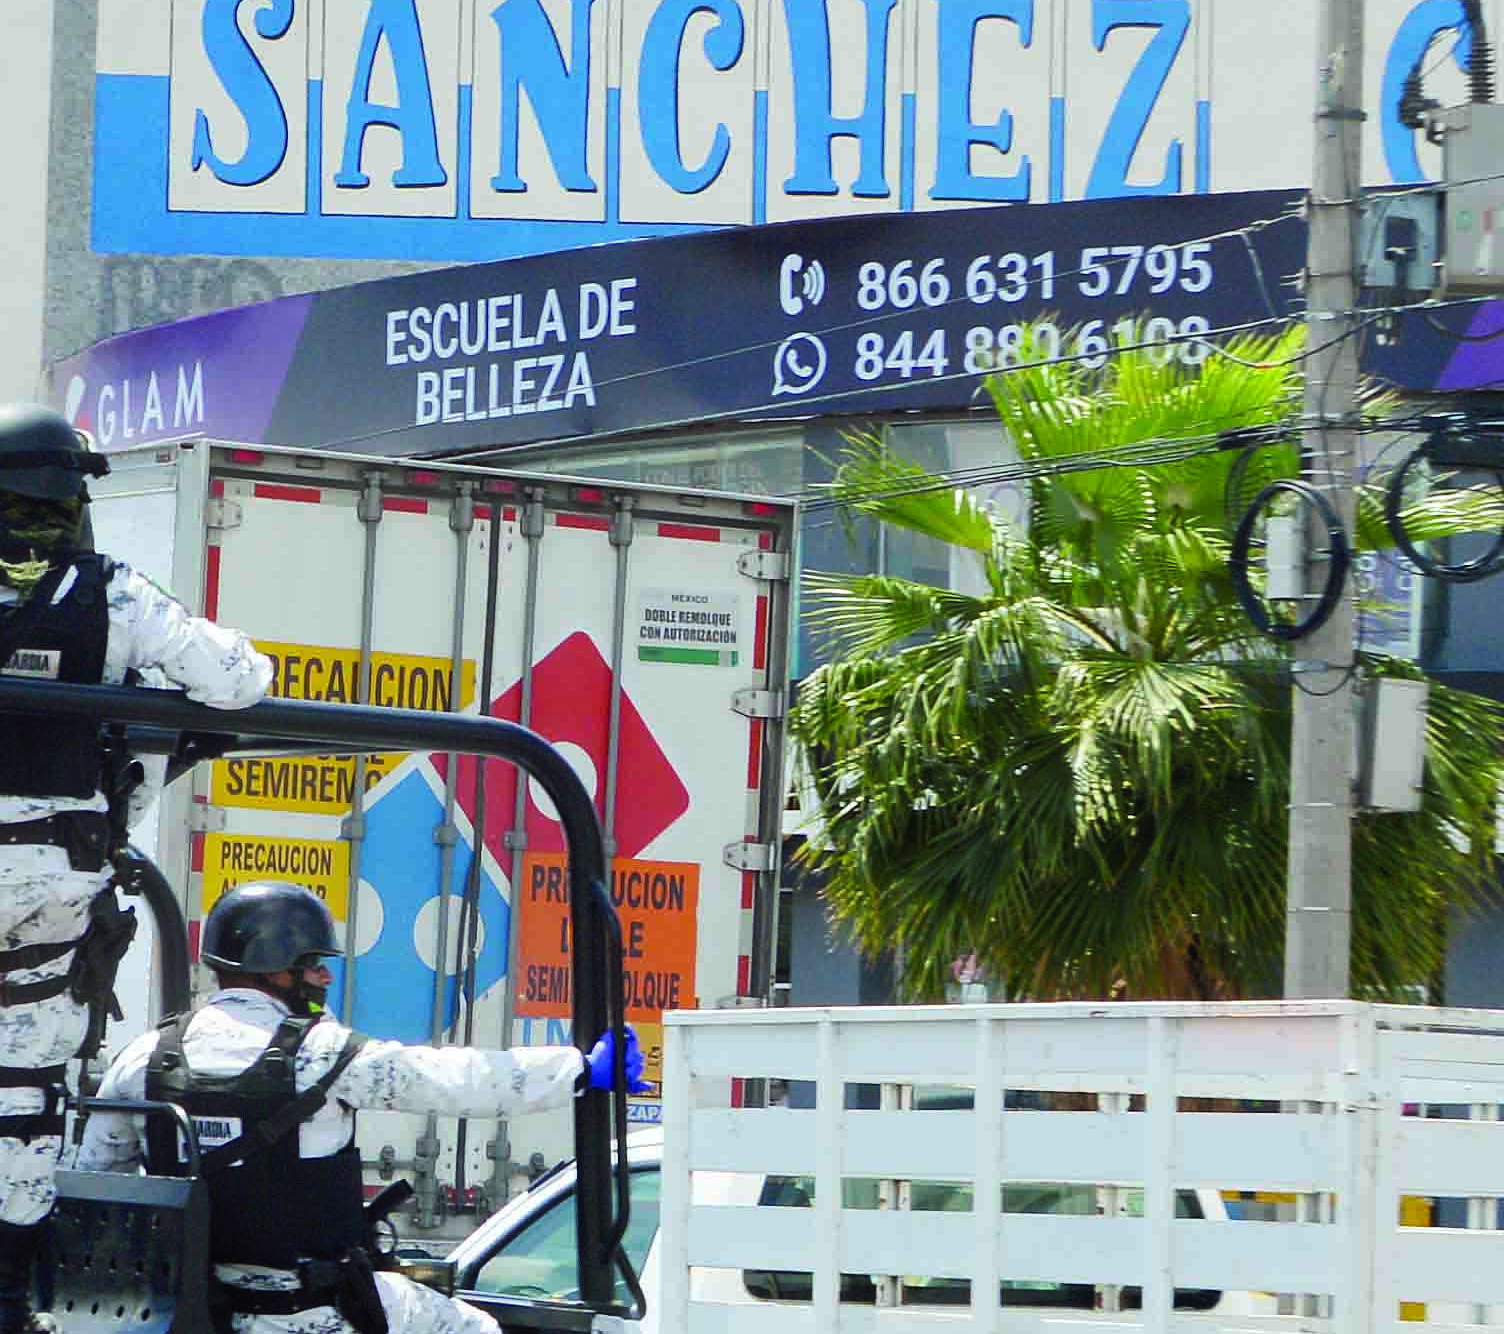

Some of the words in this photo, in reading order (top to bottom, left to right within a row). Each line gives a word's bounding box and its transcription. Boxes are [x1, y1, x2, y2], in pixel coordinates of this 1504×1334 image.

[856, 257, 950, 310] 866
[965, 250, 1056, 304] 631
[1078, 243, 1213, 297] 5795
[385, 288, 567, 365] ESCUELA
[579, 277, 637, 340] DE
[854, 327, 948, 381] 844
[96, 360, 206, 446] GLAM
[415, 350, 597, 427] BELLEZA
[639, 626, 661, 639] CON
[644, 608, 677, 624] DOBLE
[679, 610, 732, 627] REMOLQUE
[270, 652, 455, 713] RECAUCION
[221, 840, 333, 876] PRECAUCION
[530, 864, 686, 911] PRUCION
[526, 965, 681, 1009] SEMIOLQUE
